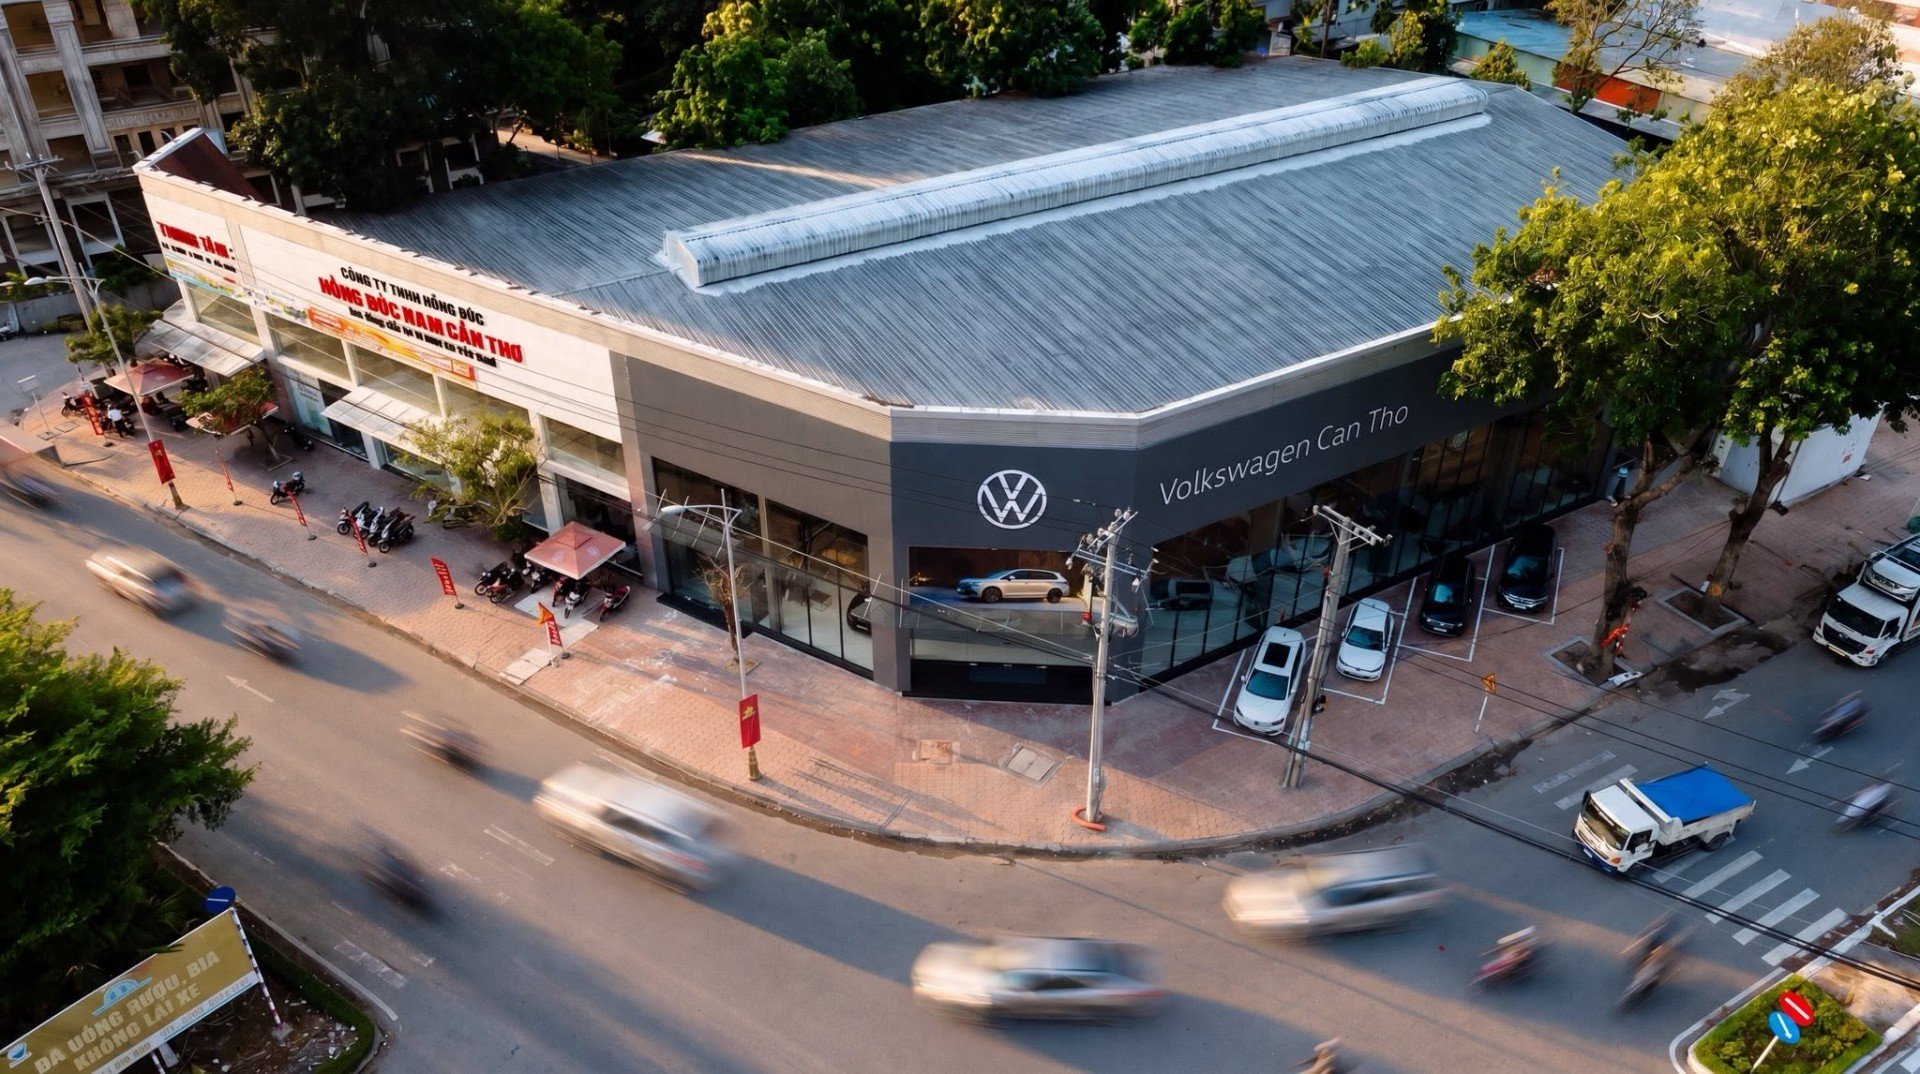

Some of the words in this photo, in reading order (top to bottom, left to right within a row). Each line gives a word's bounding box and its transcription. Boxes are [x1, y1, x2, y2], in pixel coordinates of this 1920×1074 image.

[340, 266, 372, 288] CÔNG
[372, 277, 388, 293] TY
[389, 283, 422, 305] TNHH
[401, 305, 445, 336] NAM
[485, 334, 523, 364] THƠ
[1159, 438, 1310, 505] Volkswagen
[1317, 421, 1361, 451] Can
[1368, 405, 1409, 435] Tho
[185, 950, 220, 979] BIA
[175, 982, 201, 1007] XE
